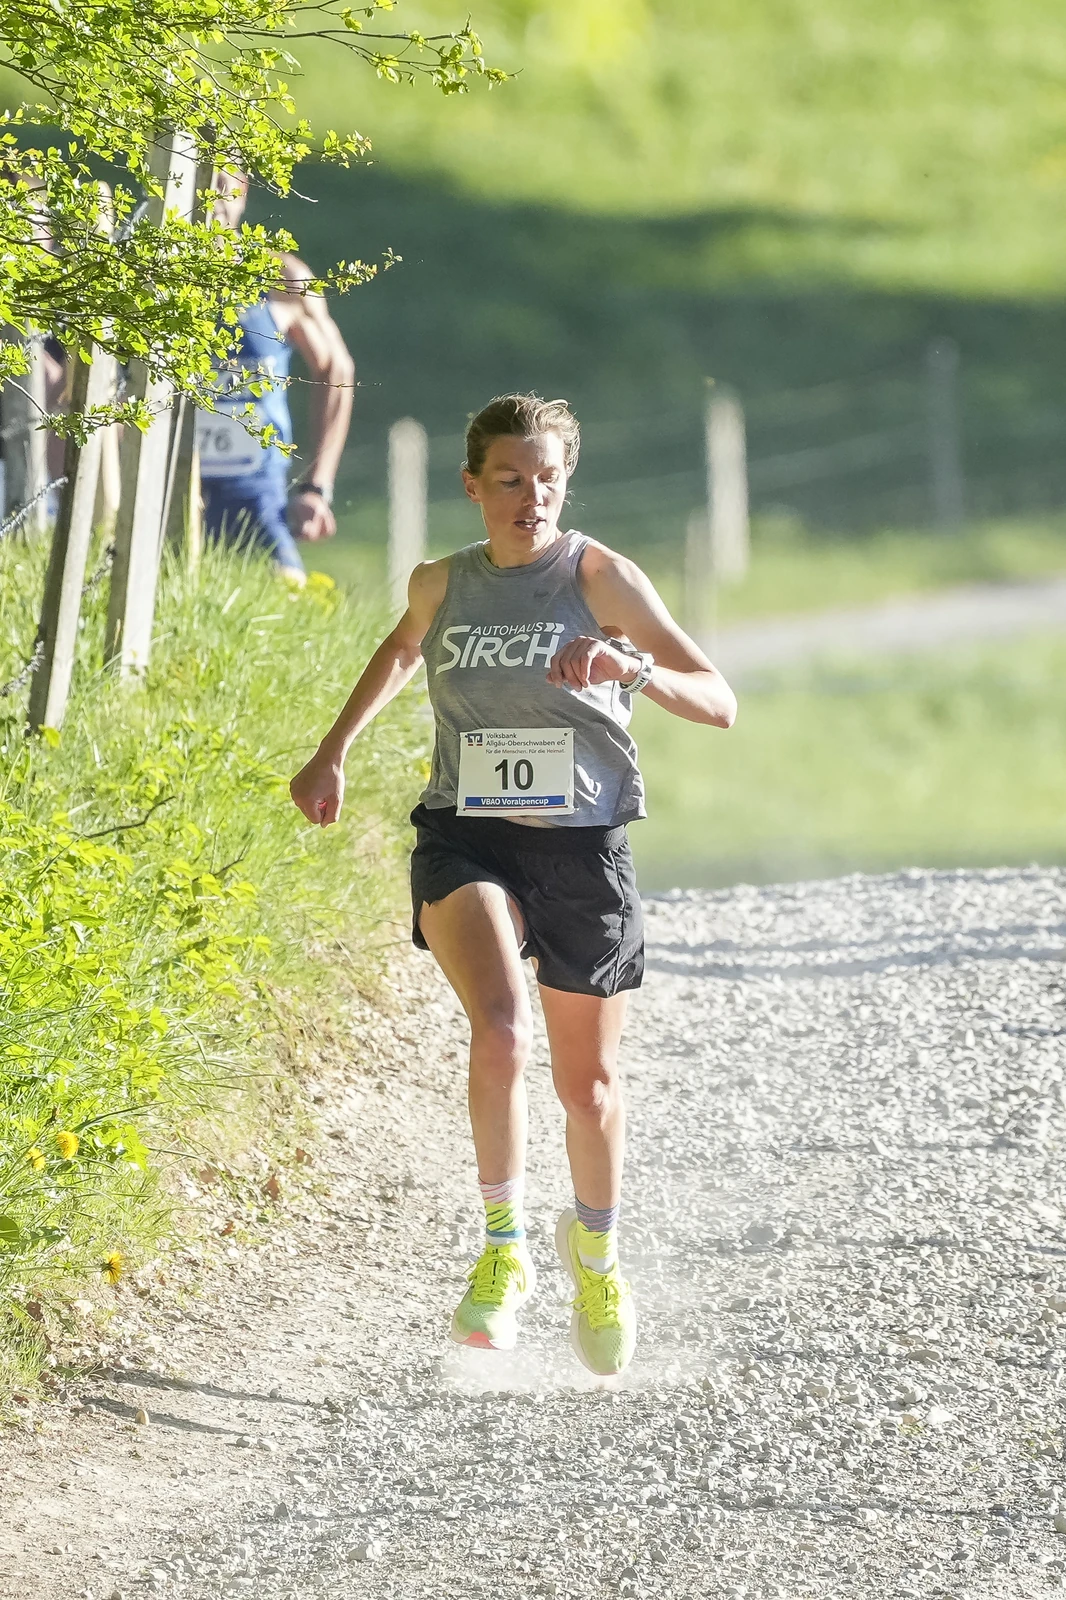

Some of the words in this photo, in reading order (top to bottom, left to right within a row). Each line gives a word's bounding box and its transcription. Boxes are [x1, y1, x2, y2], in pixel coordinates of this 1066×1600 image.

[471, 621, 544, 636] AUTOHAUS
[435, 625, 560, 676] SIRCH
[486, 739, 555, 748] Allgäu-Oberschwaben
[494, 758, 534, 791] 10
[481, 798, 501, 806] VBAO
[501, 797, 549, 807] Voralpencup
